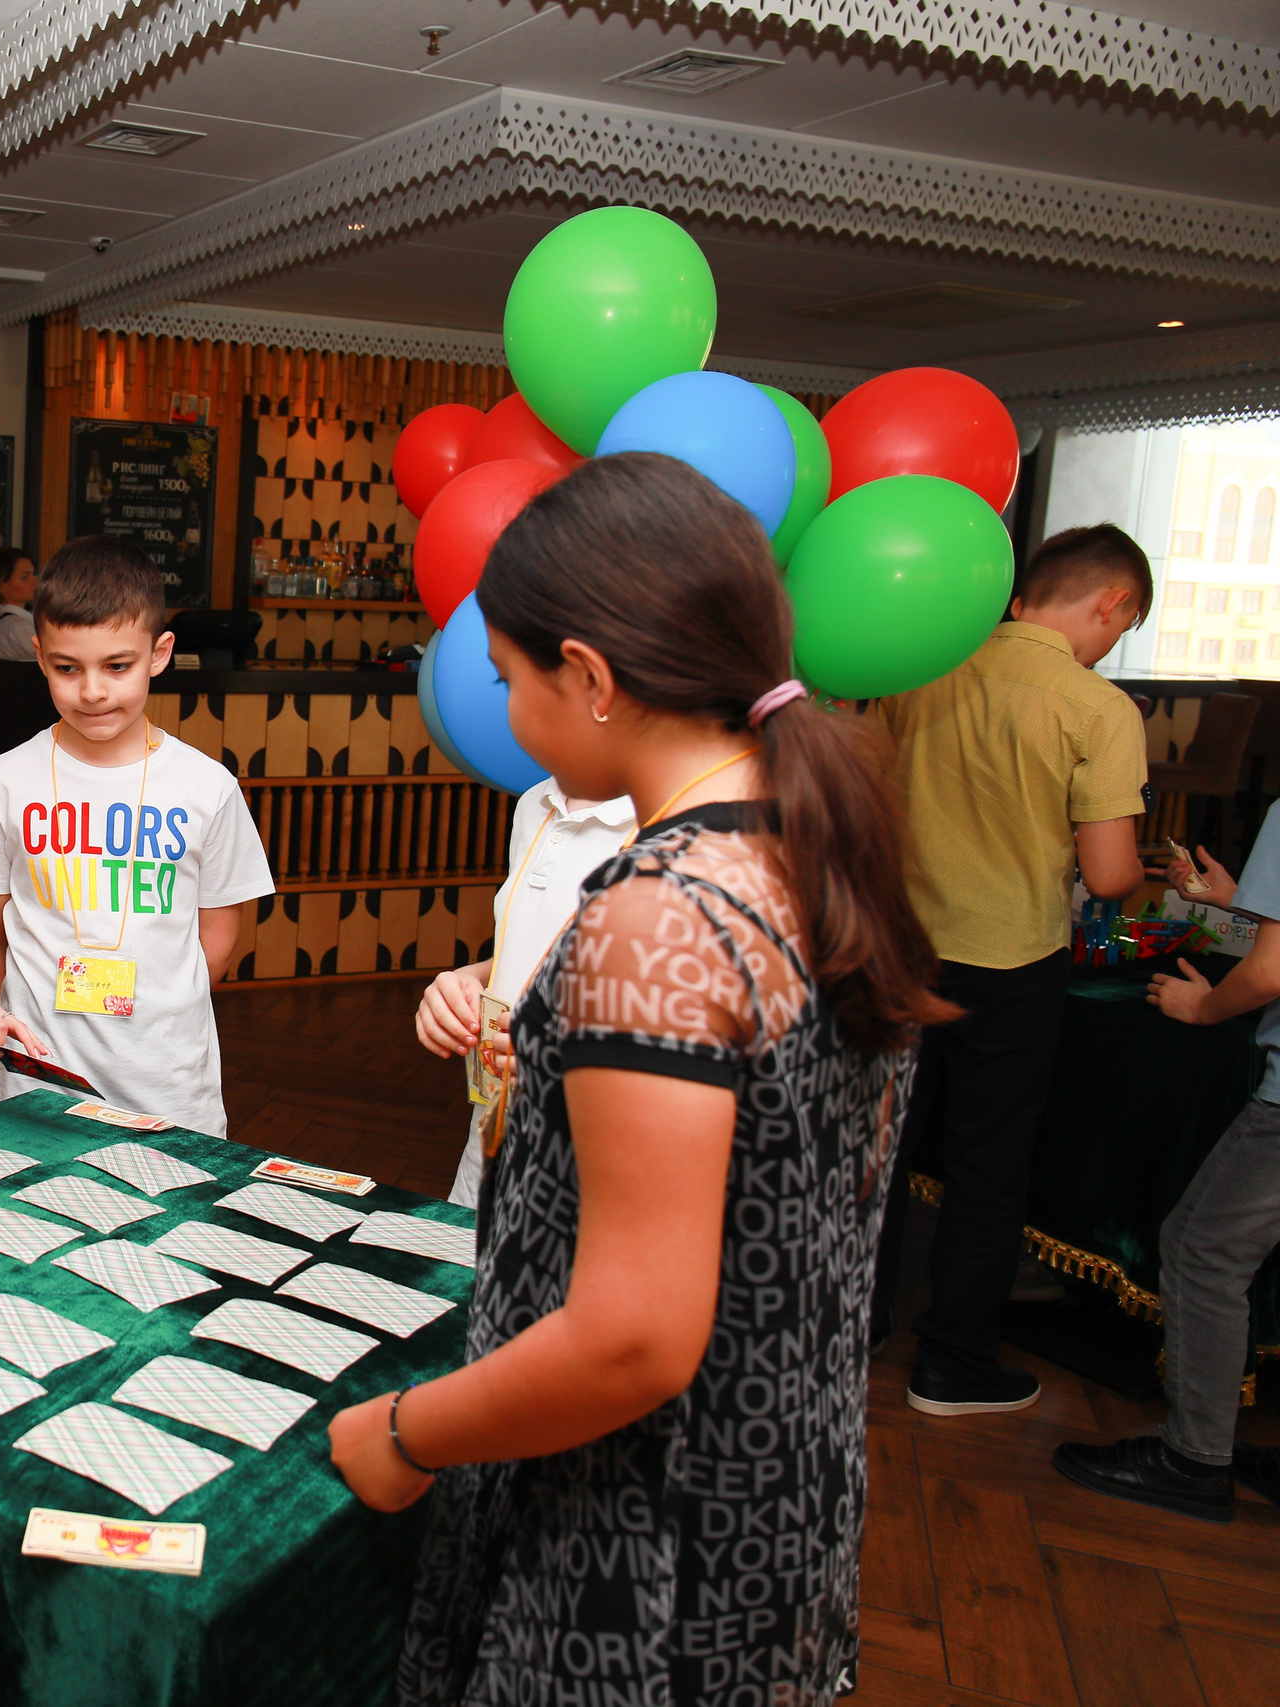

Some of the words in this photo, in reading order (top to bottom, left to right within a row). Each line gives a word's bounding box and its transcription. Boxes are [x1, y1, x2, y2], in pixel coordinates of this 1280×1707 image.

[22, 802, 188, 860] COLORS
[27, 857, 177, 915] UNITED
[551, 968, 708, 1031] OTHING
[521, 1153, 579, 1237] KEE
[733, 1185, 822, 1241] ORK
[699, 1351, 821, 1418] YORK
[681, 1451, 784, 1499] EEP
[700, 1471, 825, 1541] DKNY
[692, 1516, 828, 1579] YORK
[540, 1621, 671, 1678] YORK
[702, 1624, 826, 1694] DKNY
